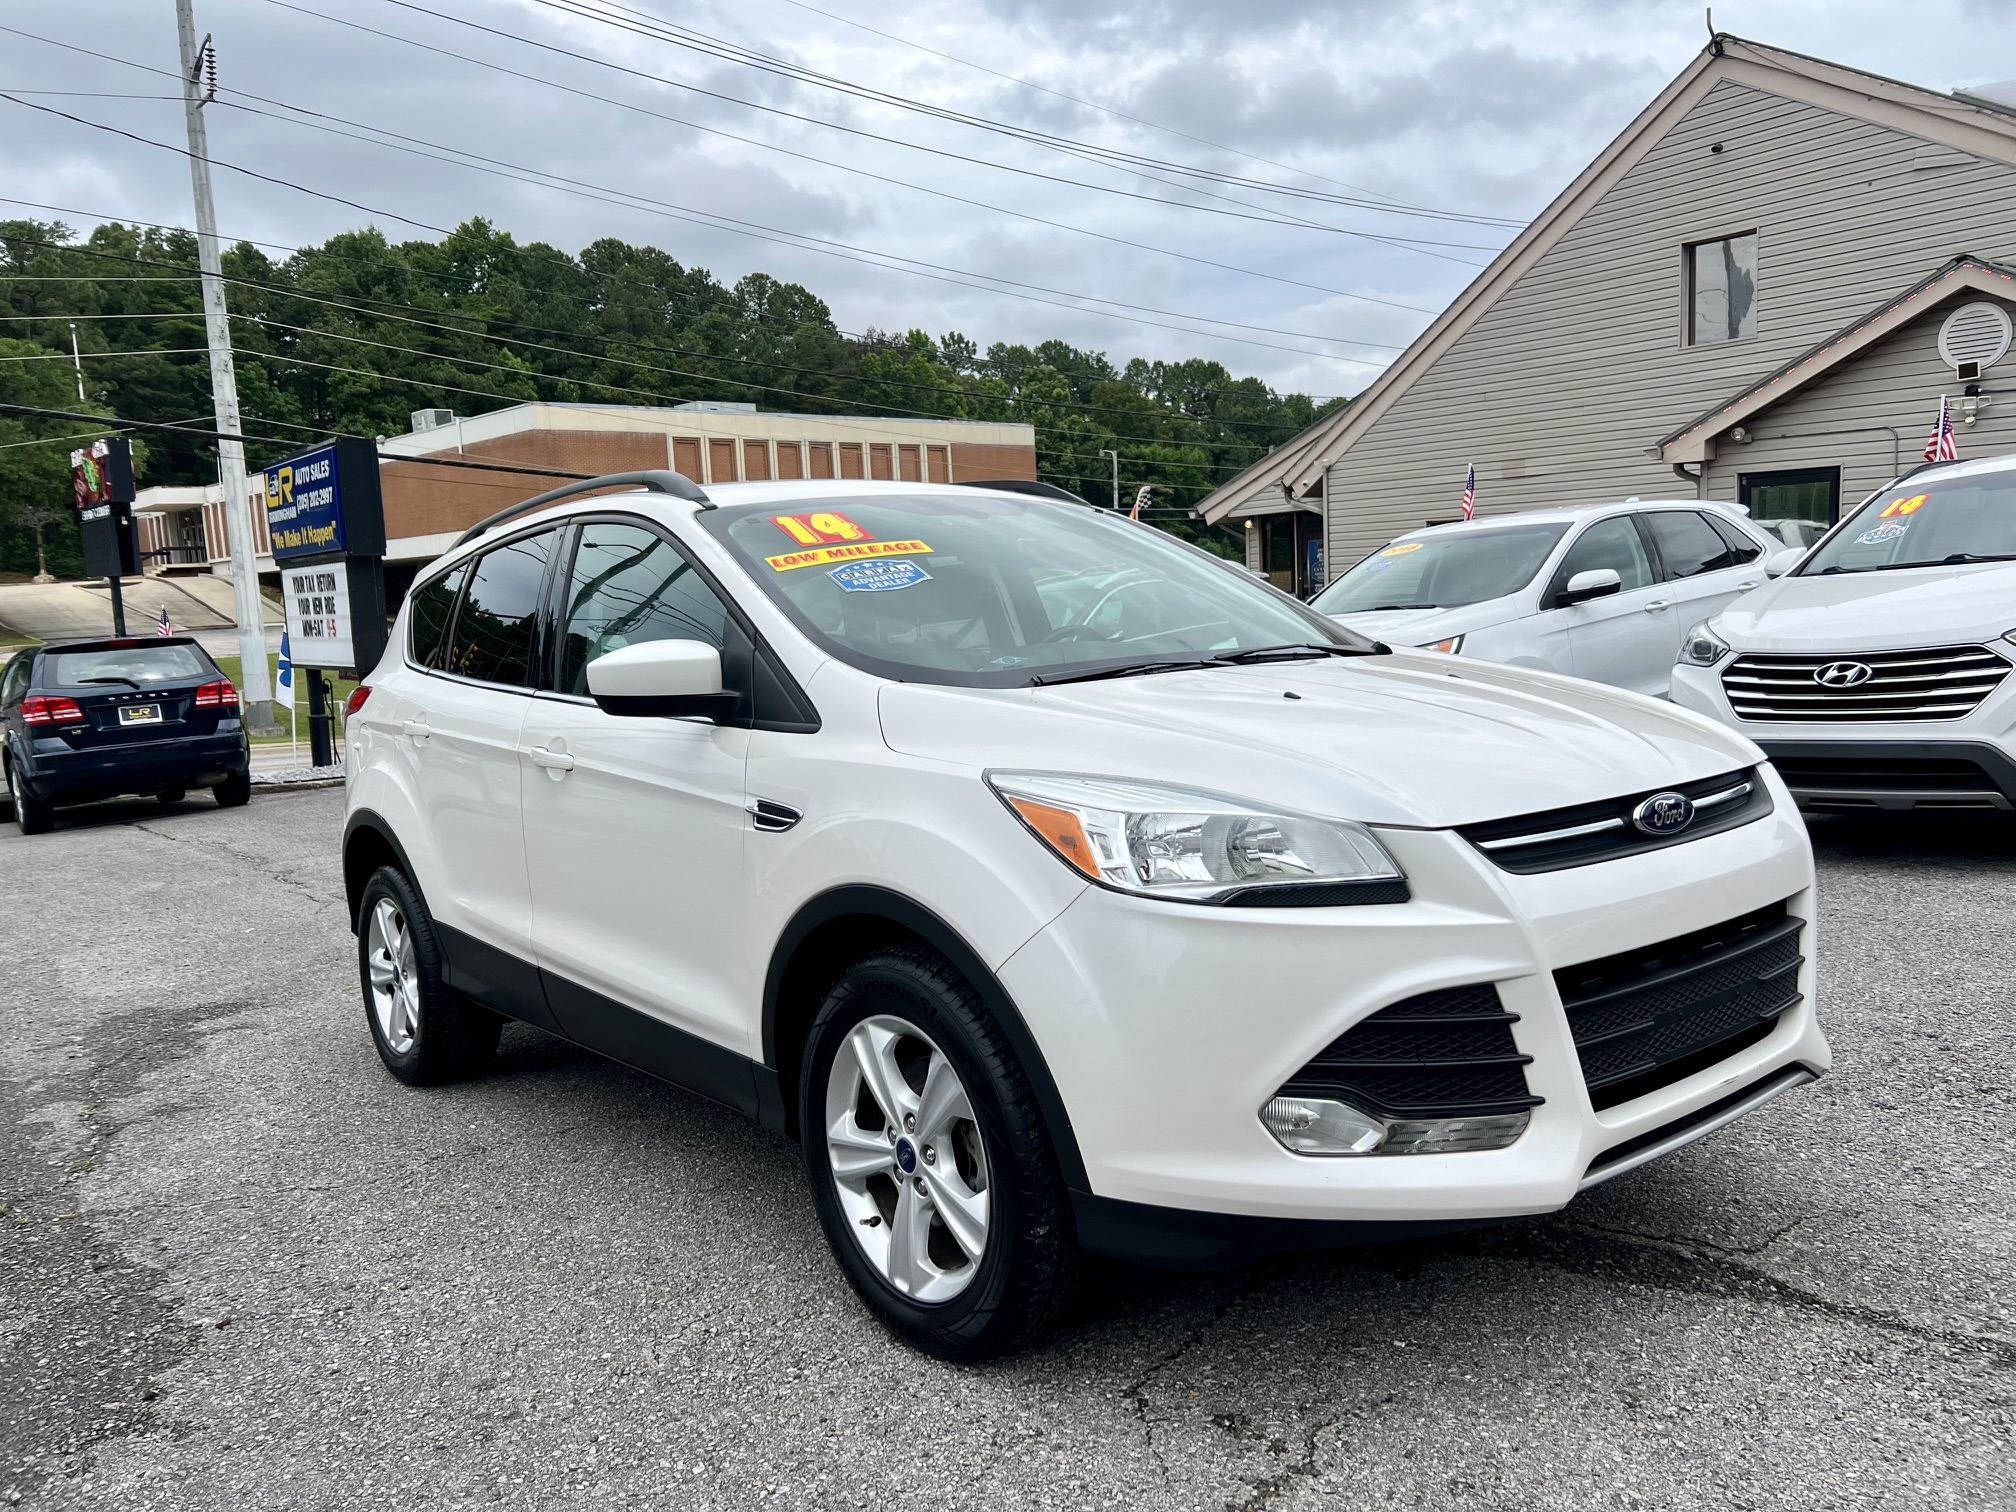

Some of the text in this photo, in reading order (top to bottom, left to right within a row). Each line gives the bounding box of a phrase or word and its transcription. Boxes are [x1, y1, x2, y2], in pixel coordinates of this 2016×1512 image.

[295, 459, 330, 486] AUTO SALES
[264, 466, 293, 508] LR
[1879, 494, 1928, 518] 14
[283, 529, 302, 548] Make
[301, 526, 309, 545] It
[776, 513, 864, 545] 14
[771, 542, 925, 568] LOW MILEAGE
[837, 563, 914, 581] CARFAX
[852, 571, 916, 586] ADVANTAGE
[291, 572, 337, 595] YOUR TAX RETURN
[868, 578, 912, 589] DEALER
[297, 597, 312, 616] YOUR
[323, 596, 336, 615] RIDE
[301, 619, 324, 637] MON-SAT
[128, 708, 151, 716] LR
[1654, 798, 1685, 827] Ford
